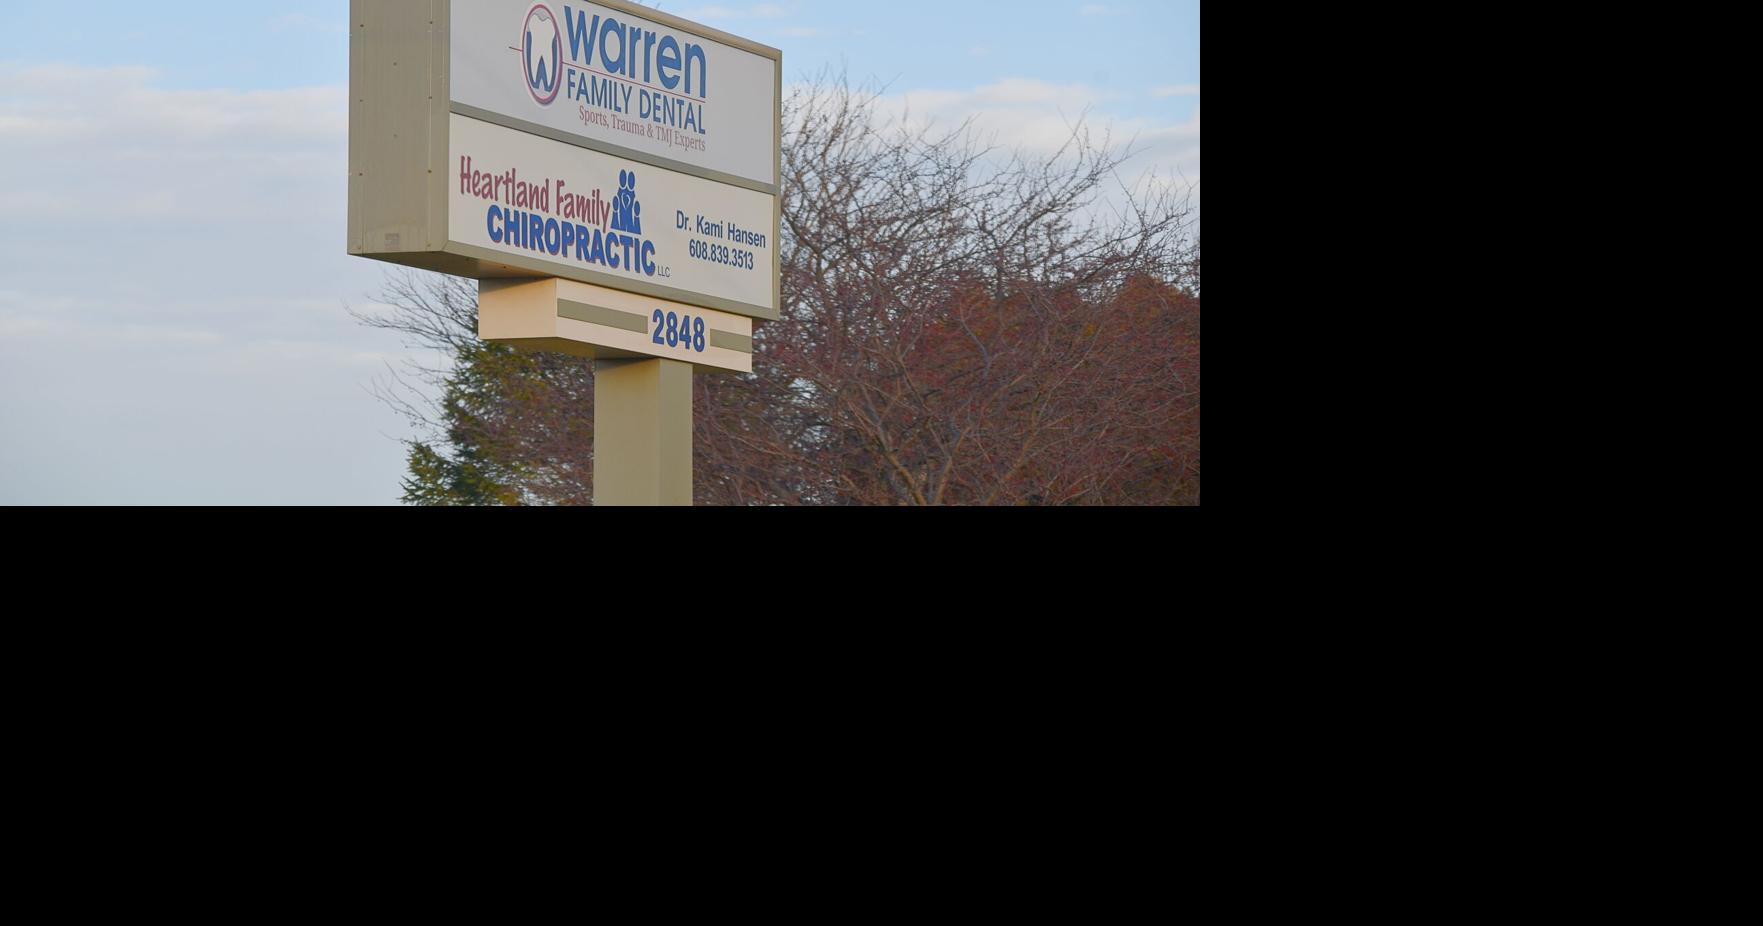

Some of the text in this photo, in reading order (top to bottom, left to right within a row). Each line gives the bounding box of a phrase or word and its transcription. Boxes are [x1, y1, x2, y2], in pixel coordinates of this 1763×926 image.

[567, 69, 706, 134] FAMILY DENTAL
[579, 106, 706, 152] Sports, Trauma & TMJ Experts
[460, 156, 611, 233] Heartland Family
[487, 204, 671, 278] CHIROPRACTIC LLC
[676, 210, 766, 249] Dr. Kami Hansen
[689, 240, 754, 270] 608.839.3513
[652, 308, 705, 353] 2848
